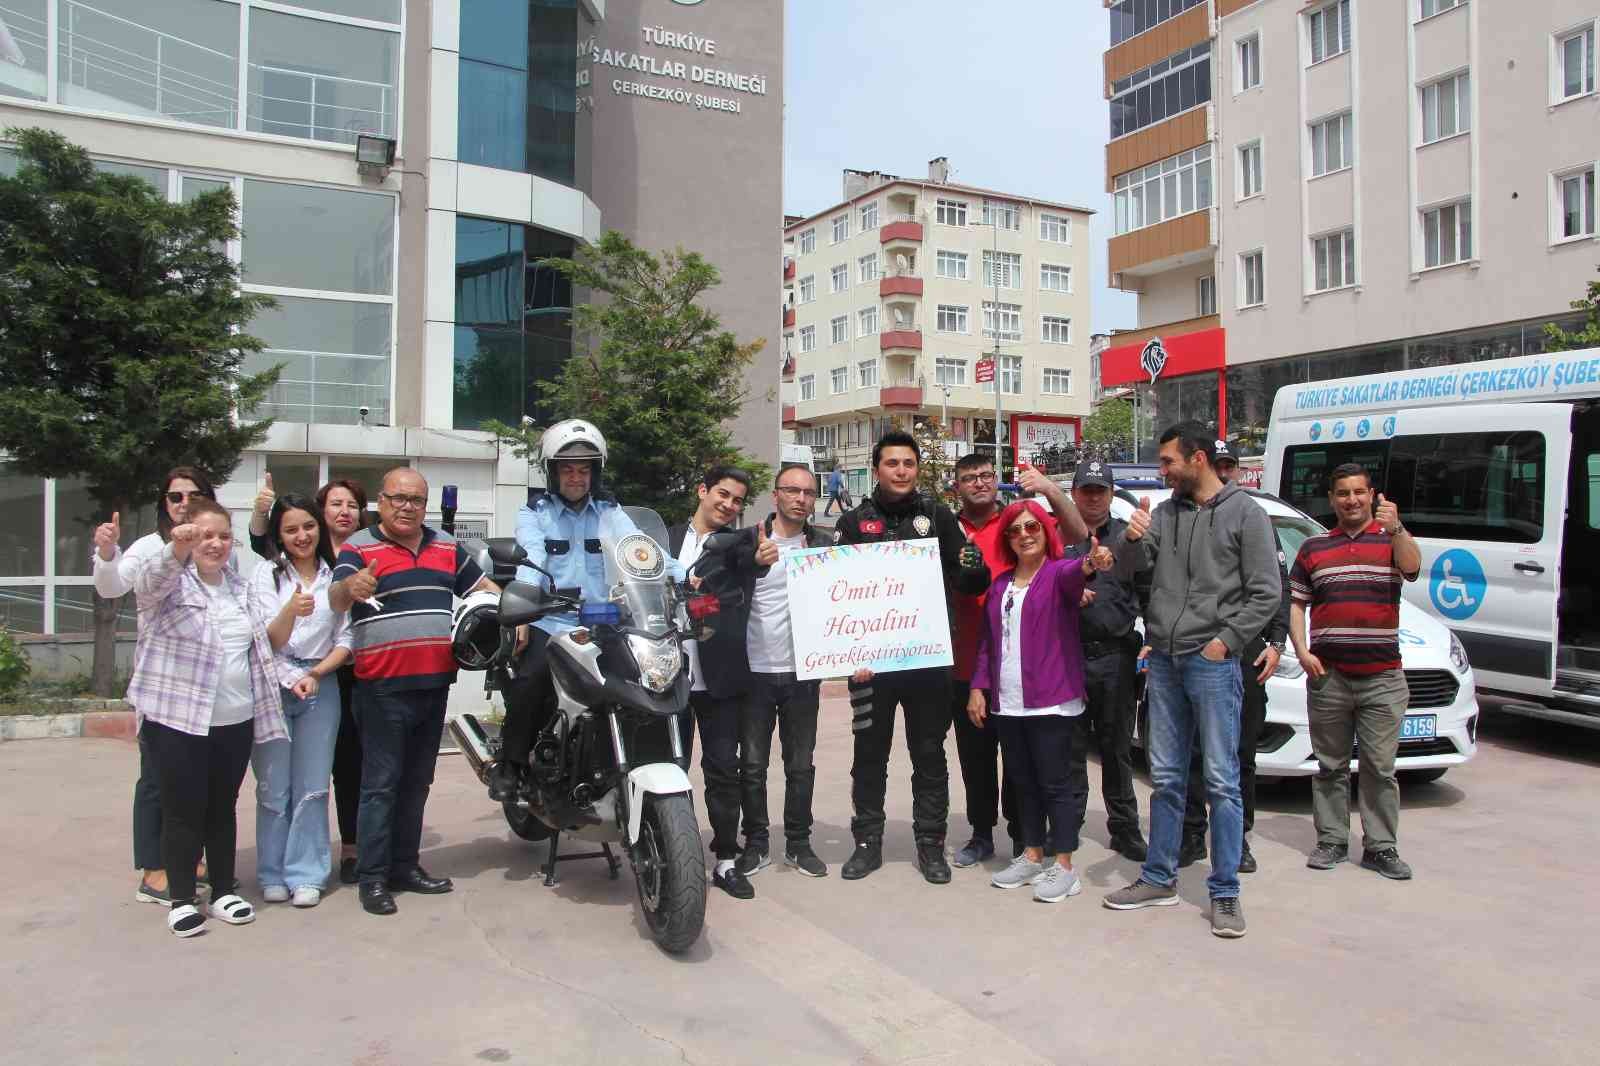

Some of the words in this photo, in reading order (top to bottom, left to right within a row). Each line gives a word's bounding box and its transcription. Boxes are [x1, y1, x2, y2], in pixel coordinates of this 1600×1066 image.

[642, 25, 716, 55] TÜRKİYE
[592, 46, 686, 79] SAKATLAR
[691, 66, 767, 94] DERNEĞİ
[612, 79, 692, 104] ÇERKEZKÖY
[694, 94, 741, 113] ŞUBESİ
[1295, 385, 1339, 410] TÜRKİYE
[1341, 380, 1397, 405] SAKATLAR
[1460, 360, 1551, 400] ÇERKEZKÖY
[1553, 359, 1600, 392] ŞUBE
[828, 576, 905, 602] Ümit'in
[823, 608, 920, 641] Hayalini
[804, 642, 947, 673] Gerçekleştiriyoruz.
[1403, 717, 1434, 736] 6159
